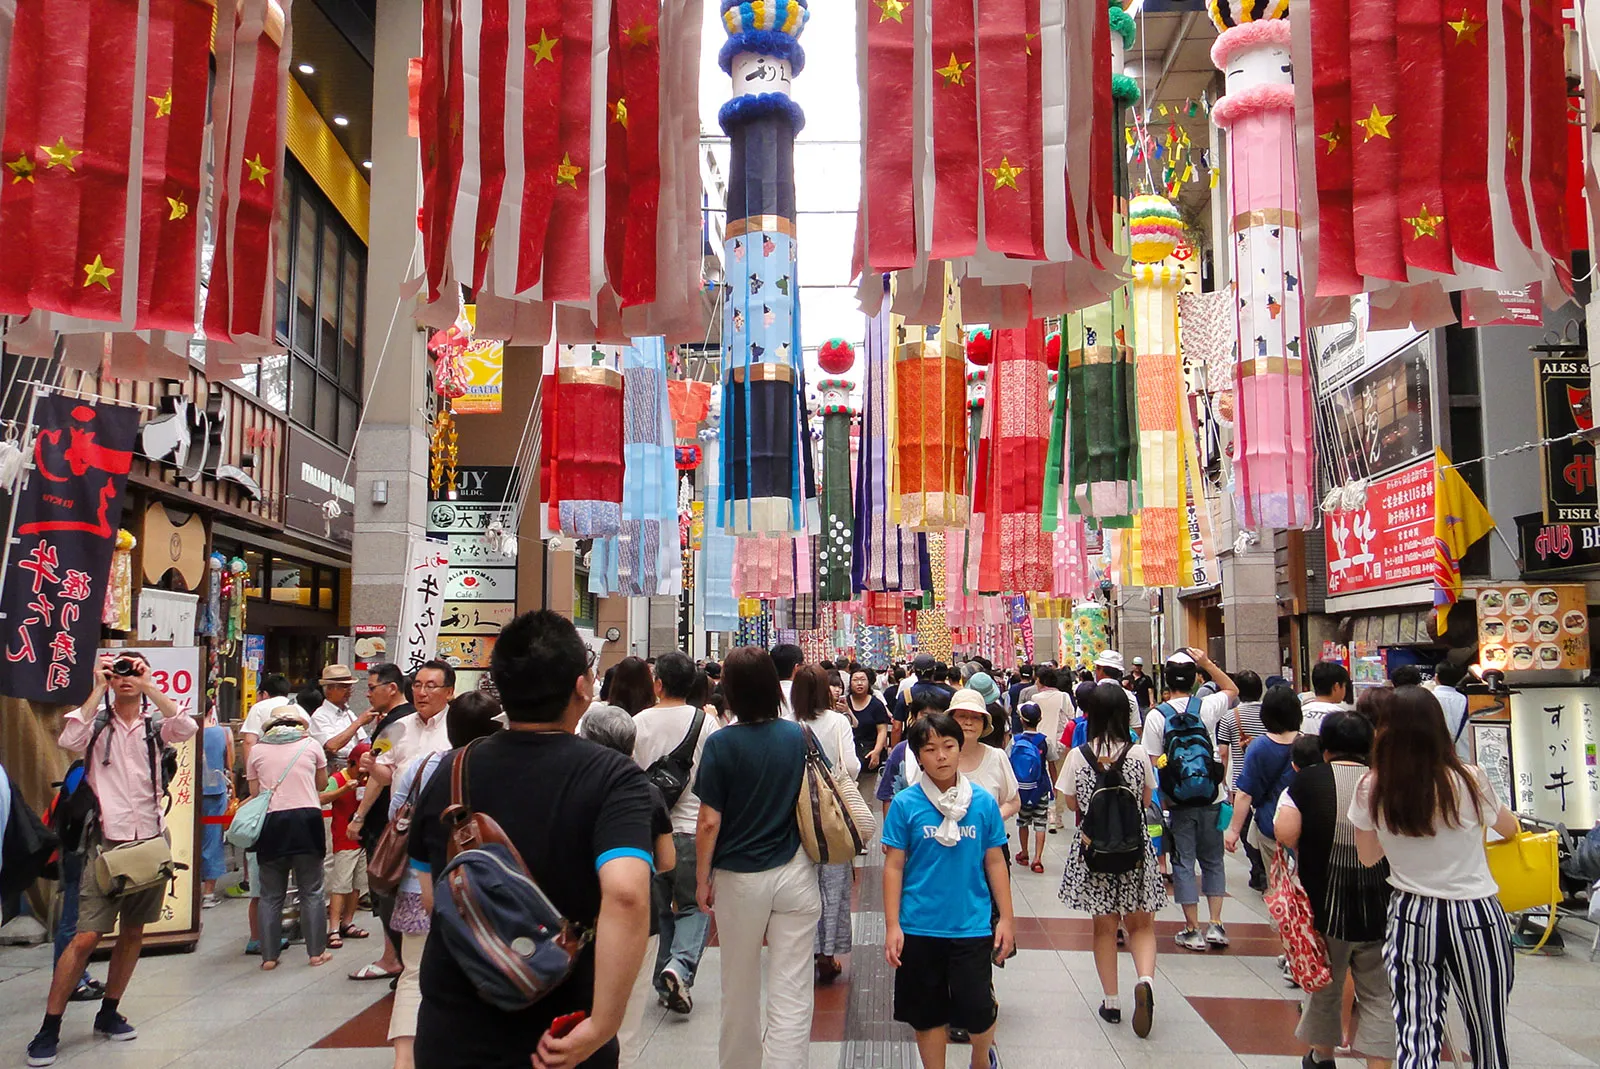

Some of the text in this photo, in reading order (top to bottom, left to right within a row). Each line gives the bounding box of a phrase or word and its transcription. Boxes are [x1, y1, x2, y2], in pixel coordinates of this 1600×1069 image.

[1542, 362, 1590, 374] ALES &
[465, 385, 500, 394] EGALTA
[457, 471, 488, 489] JY
[1559, 508, 1591, 519] FISH
[1535, 524, 1573, 560] HUB
[471, 569, 497, 587] TOMATO
[1329, 573, 1340, 592] 4F
[456, 590, 473, 598] Café
[151, 669, 192, 694] 30
